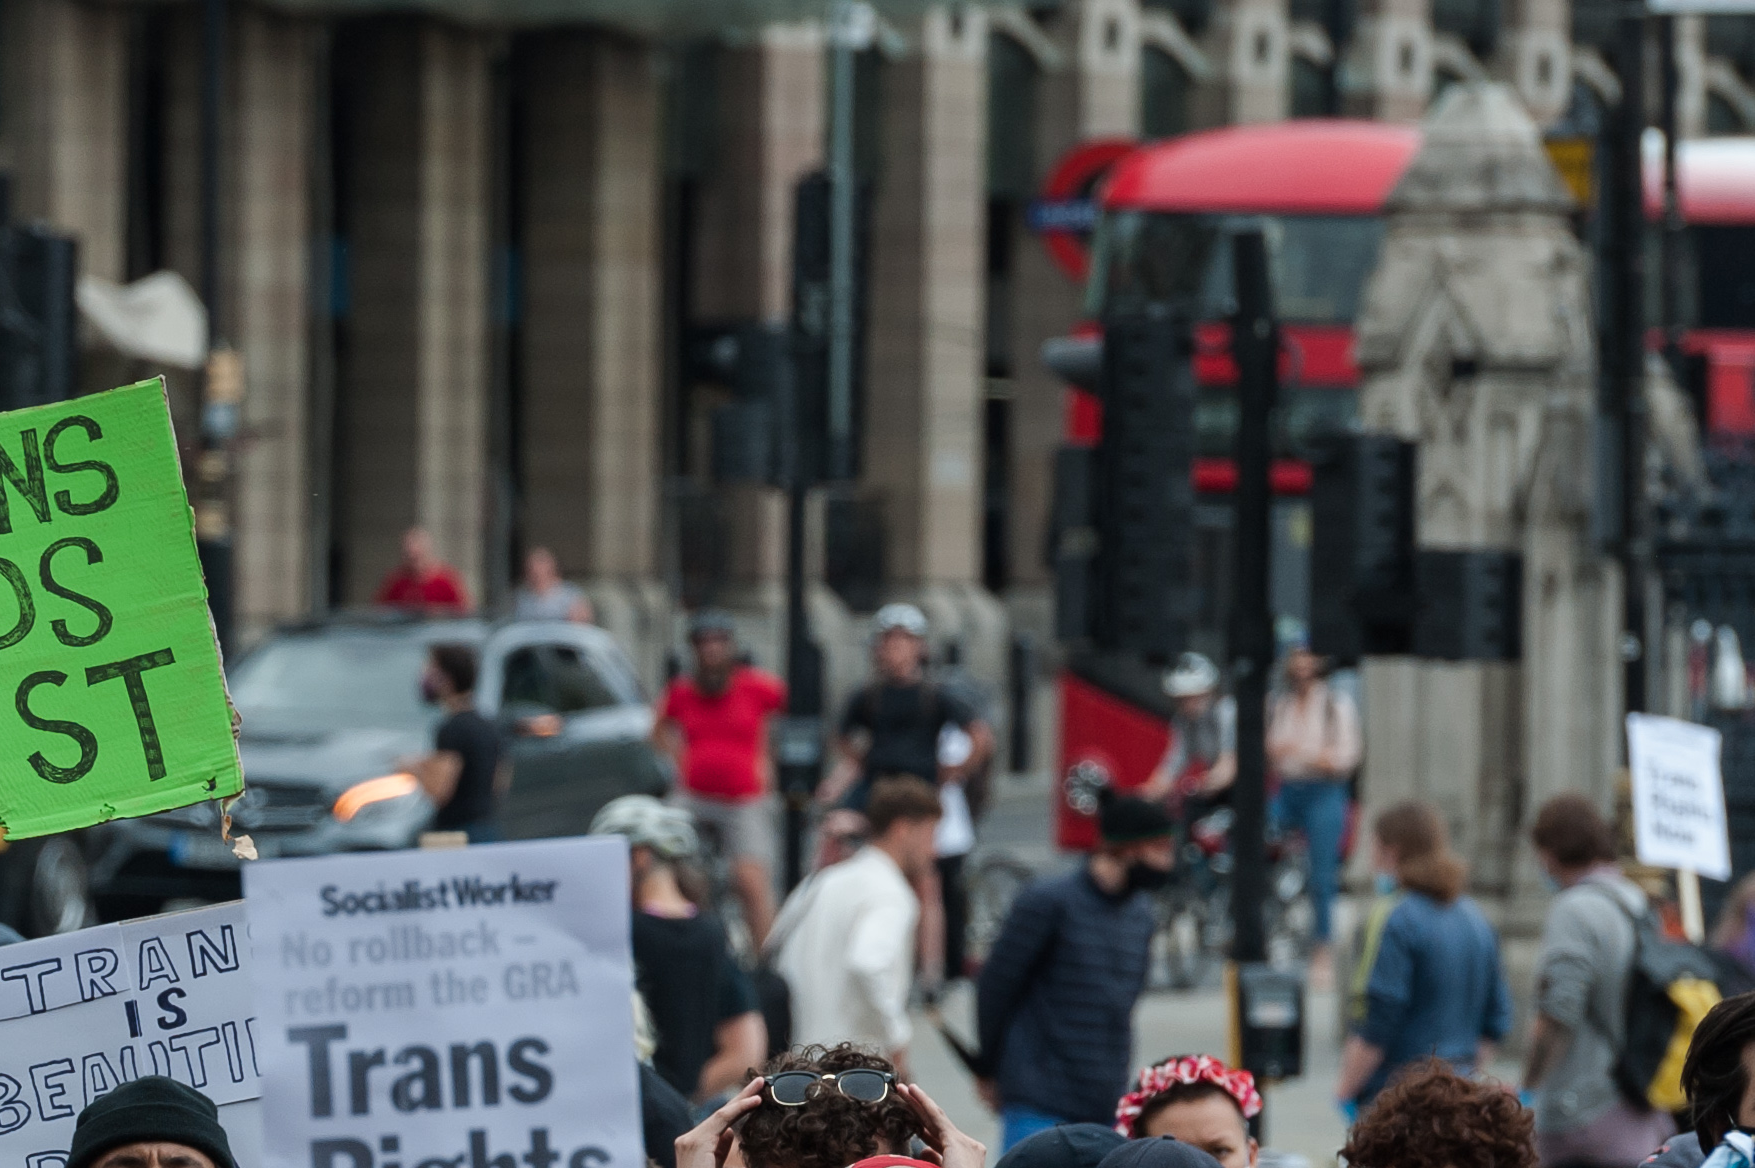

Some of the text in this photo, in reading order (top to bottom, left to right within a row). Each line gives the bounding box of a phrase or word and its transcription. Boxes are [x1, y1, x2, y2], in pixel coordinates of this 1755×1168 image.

[319, 872, 560, 918] Socialist Worker
[0, 924, 252, 1015] TRAN
[280, 930, 334, 968] No
[348, 919, 500, 966] rollback
[123, 987, 188, 1038] IS
[284, 957, 580, 1016] reform the GRA
[287, 1022, 555, 1120] Trans
